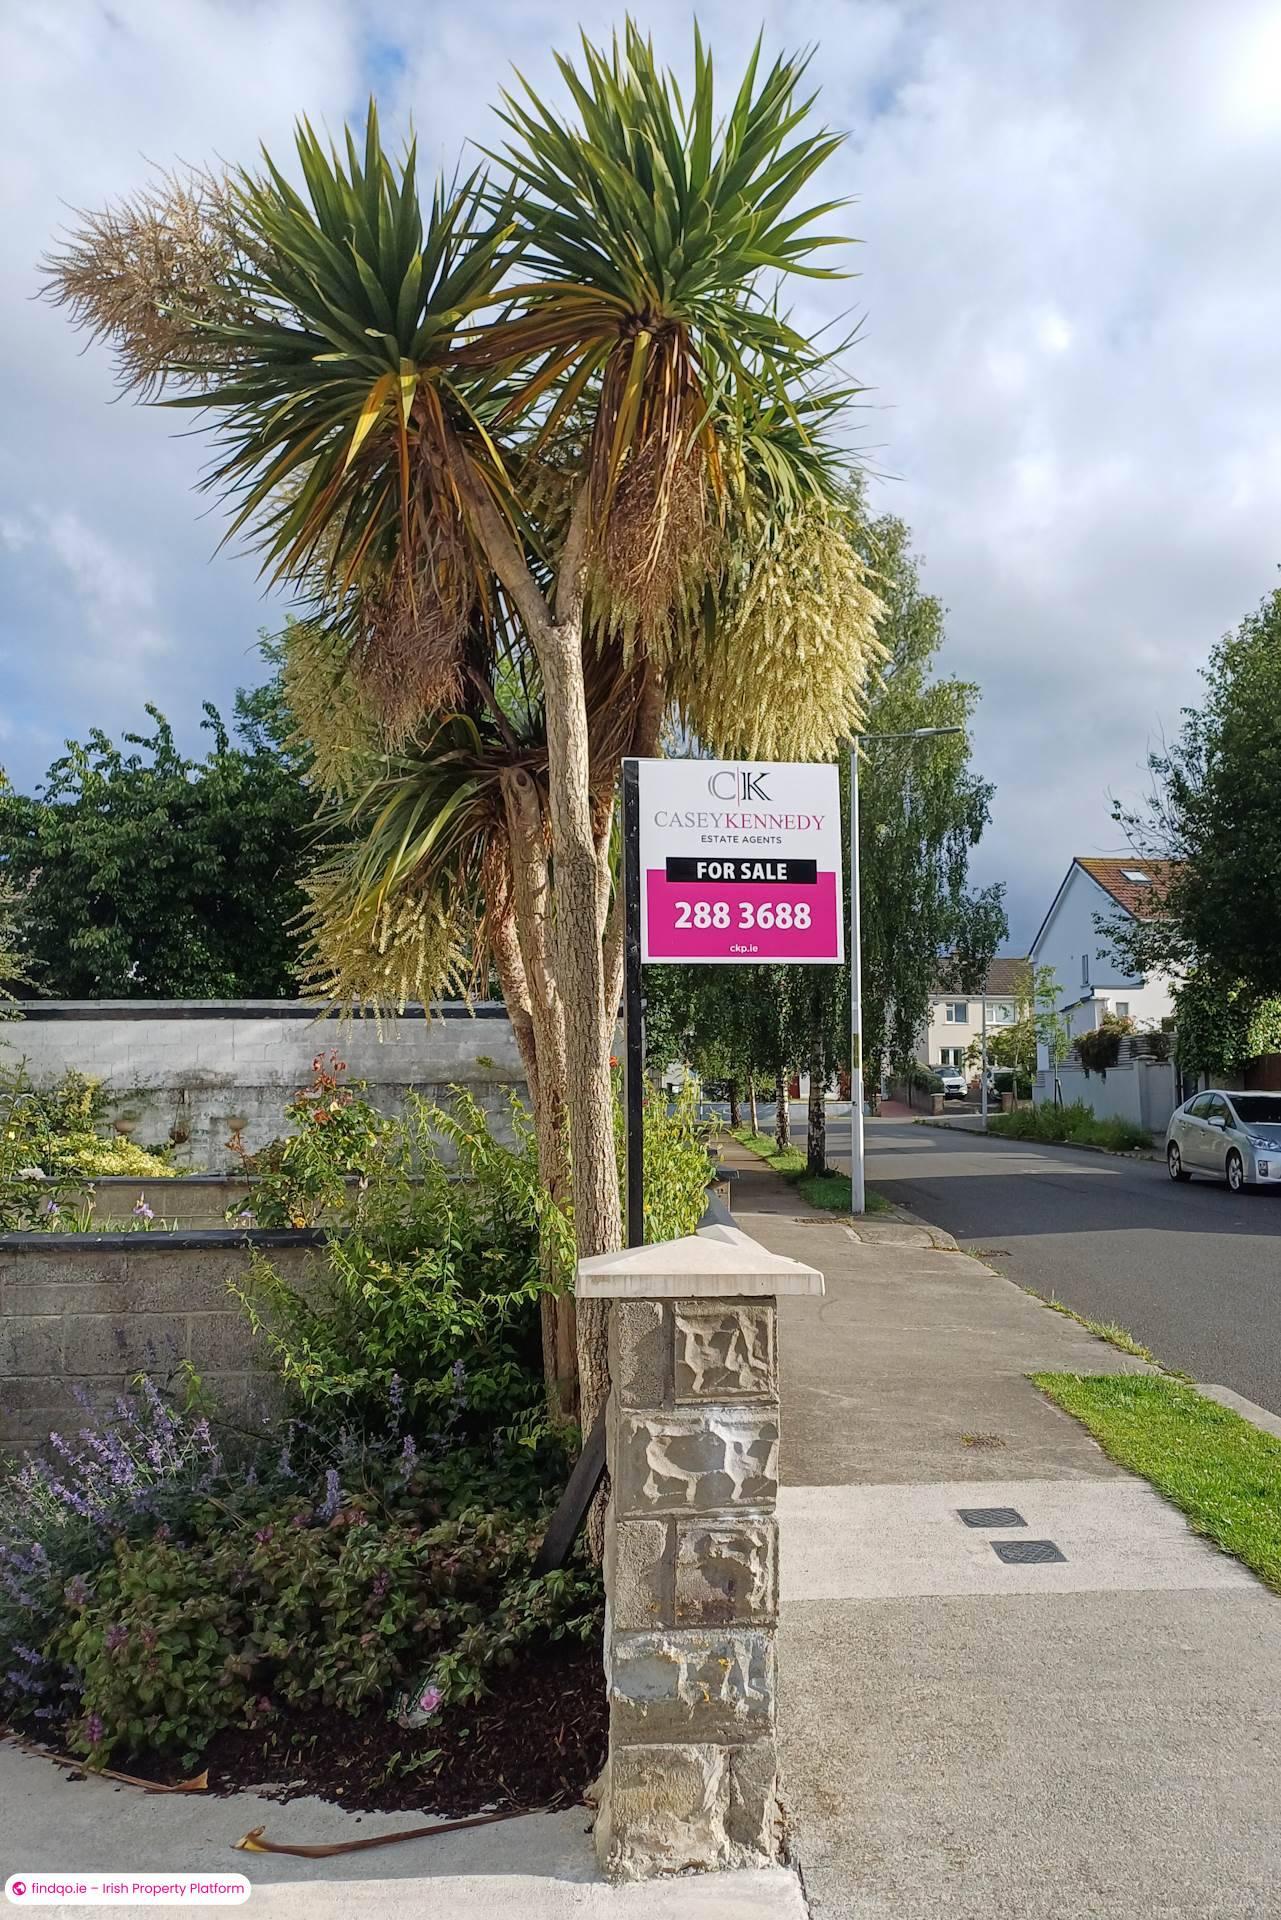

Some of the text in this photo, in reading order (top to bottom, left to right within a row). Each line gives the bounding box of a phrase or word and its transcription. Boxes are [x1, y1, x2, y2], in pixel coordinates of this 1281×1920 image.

[654, 811, 825, 831] CASEYKENNEDY
[701, 835, 782, 844] ESTATE AGENTS
[697, 862, 788, 880] FOR SALE
[674, 901, 812, 929] 288 3688
[729, 944, 759, 954] ckp.ie
